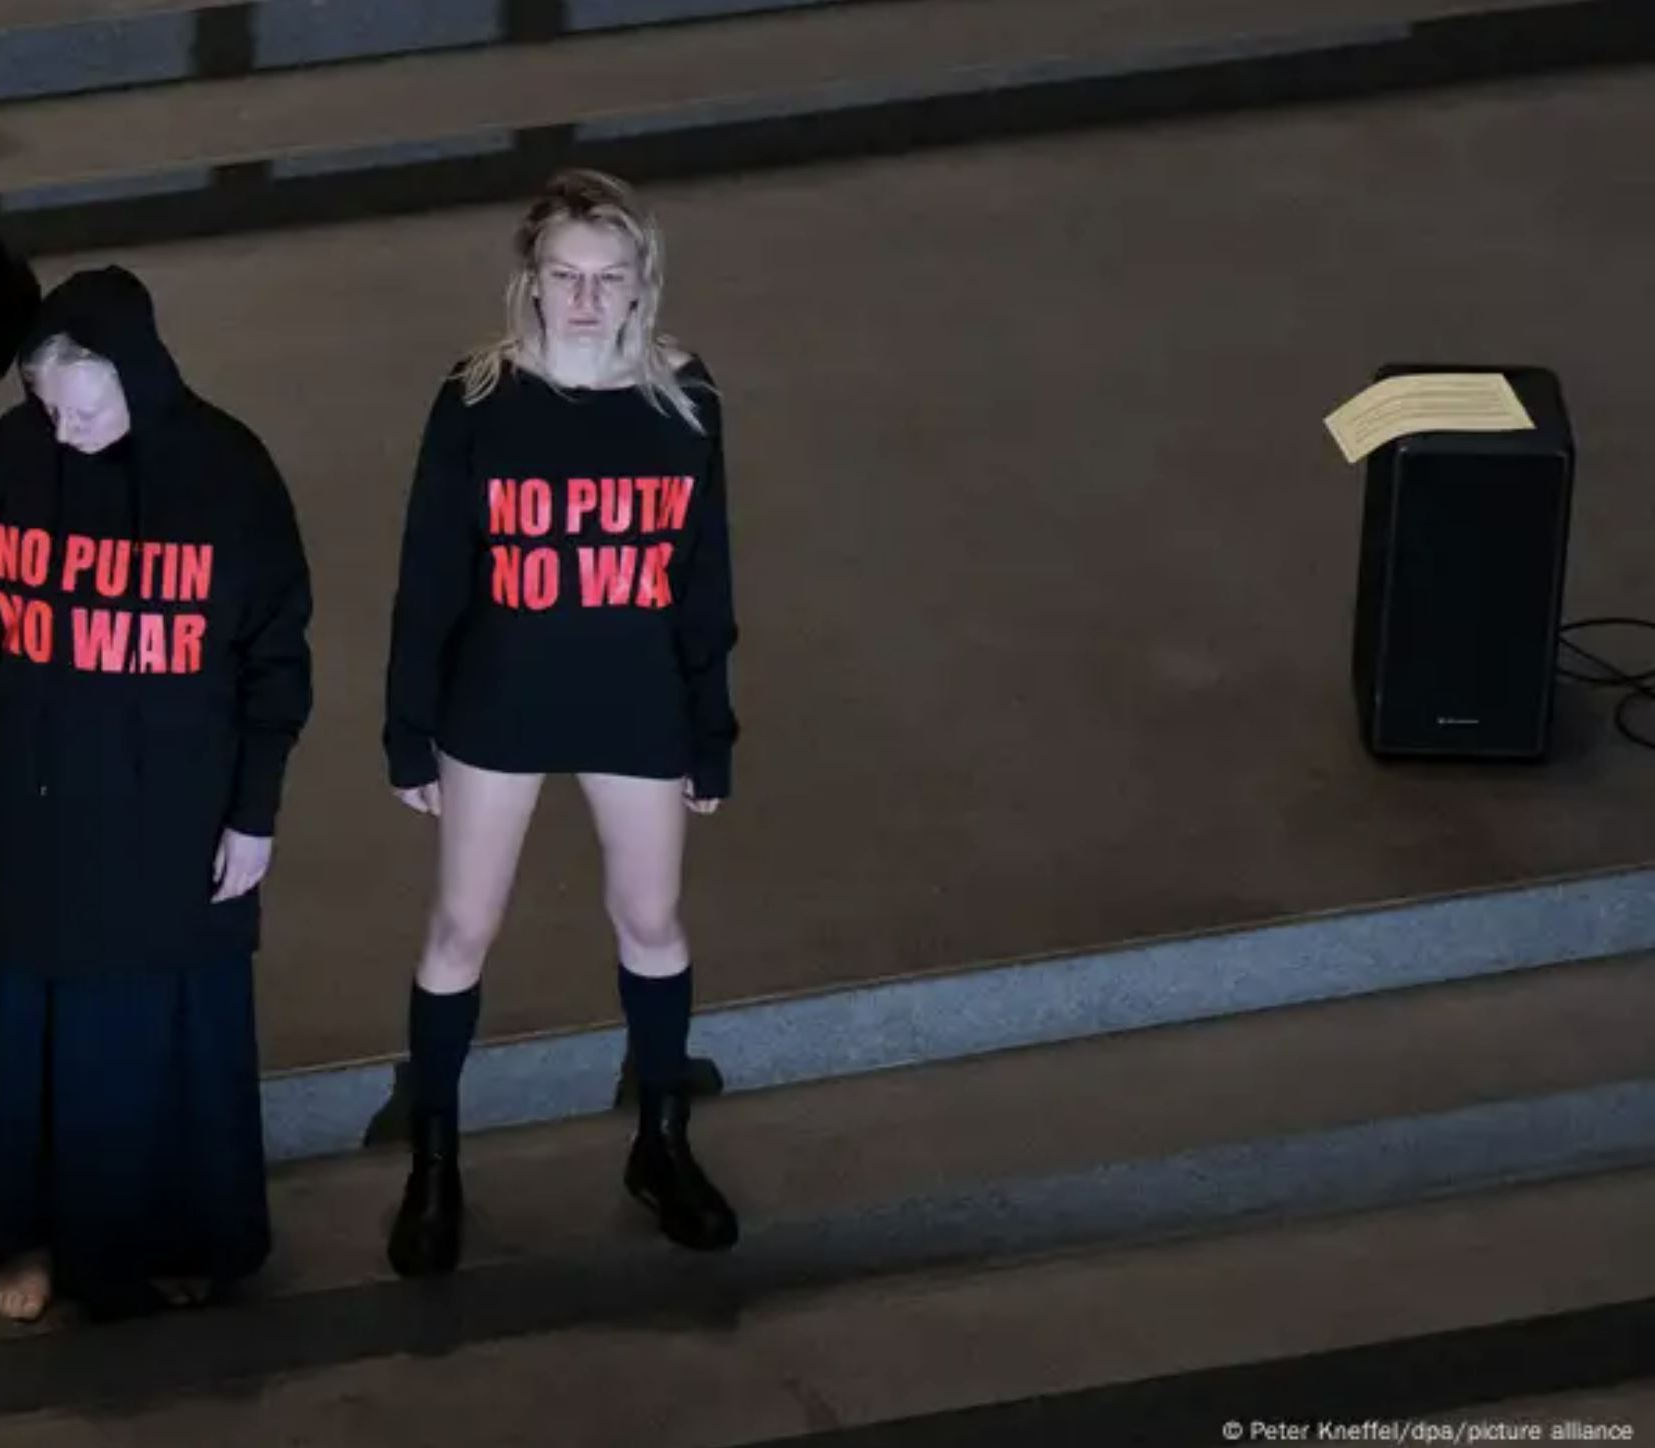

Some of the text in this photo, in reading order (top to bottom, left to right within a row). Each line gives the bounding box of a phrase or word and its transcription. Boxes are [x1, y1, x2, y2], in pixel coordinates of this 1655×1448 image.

[488, 477, 552, 537] NO
[61, 533, 214, 602] PUTIN
[491, 543, 560, 611] NO
[70, 606, 207, 675] WAR
